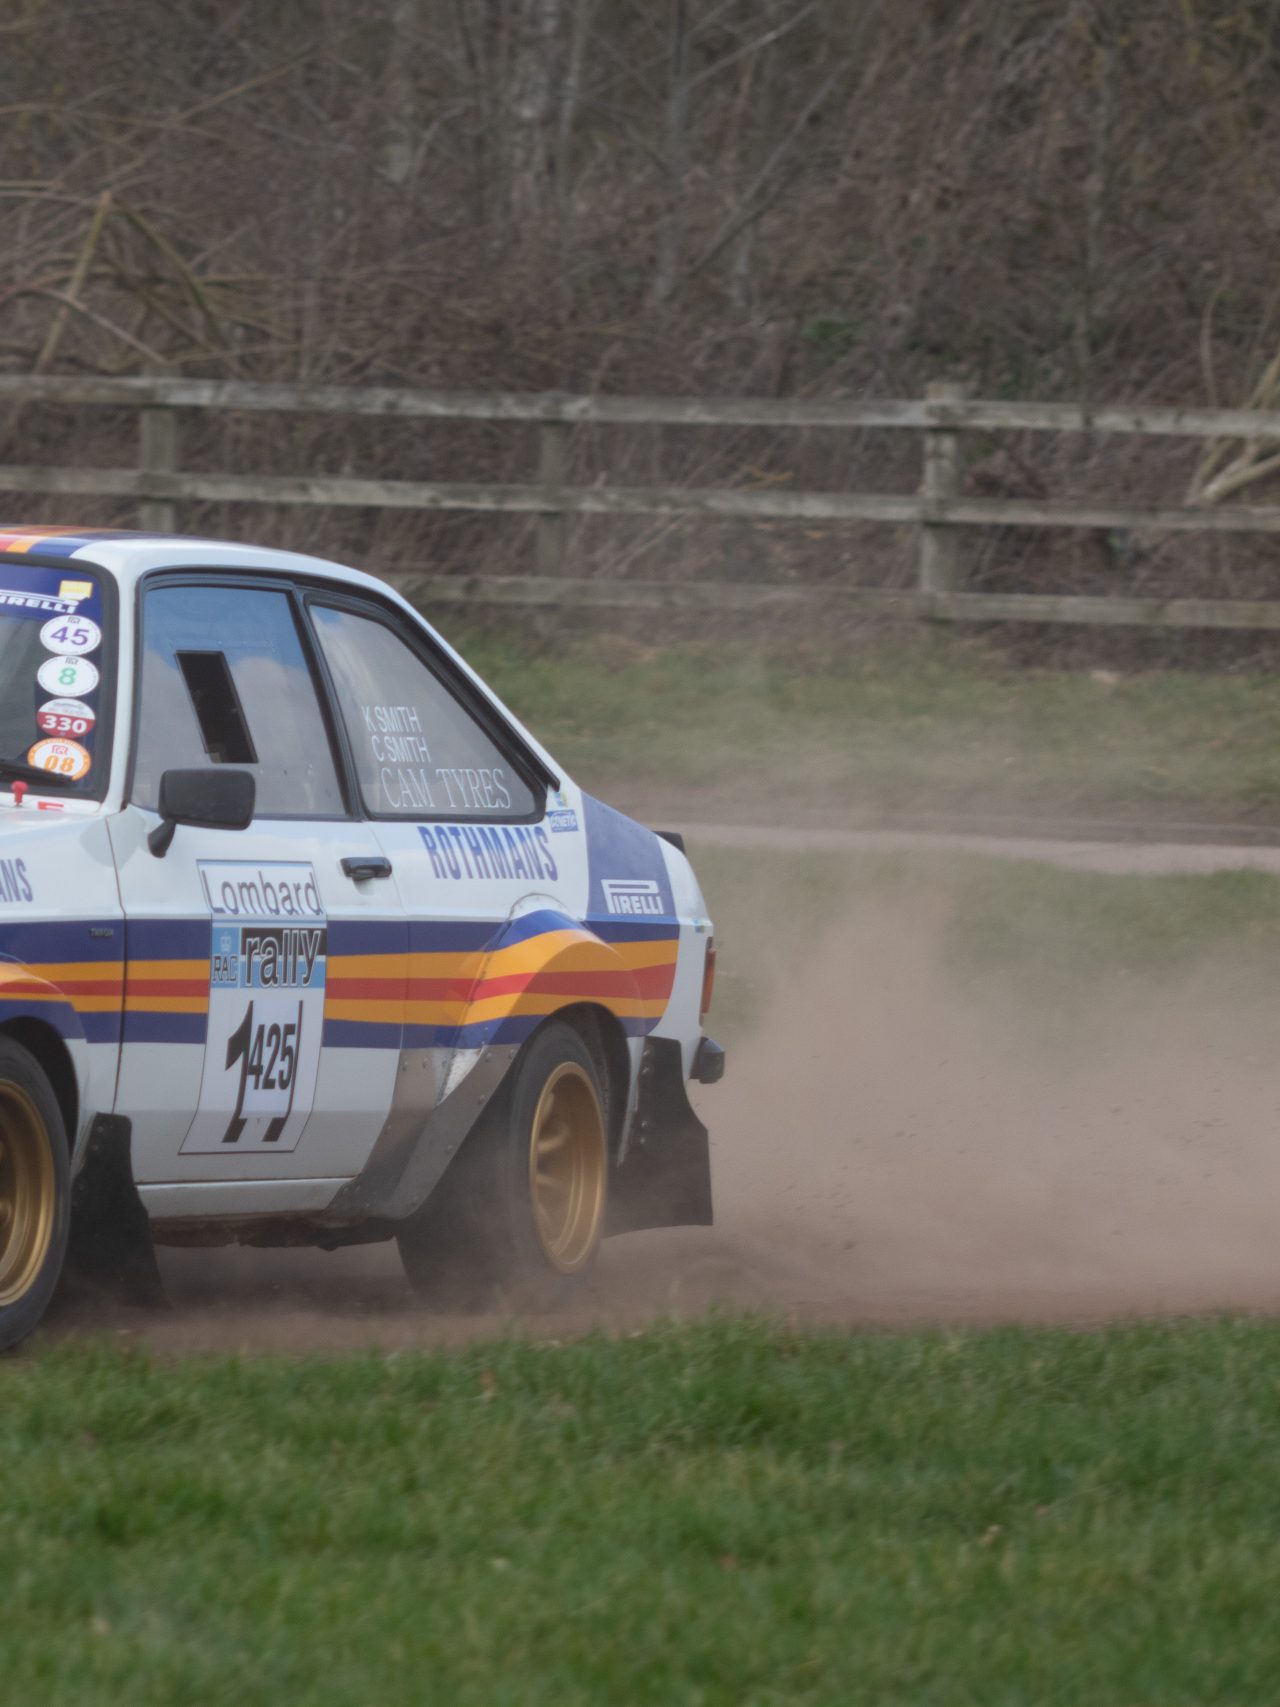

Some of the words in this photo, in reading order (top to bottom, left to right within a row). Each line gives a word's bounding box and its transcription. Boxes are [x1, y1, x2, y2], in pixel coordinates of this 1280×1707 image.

[50, 626, 89, 646] 45
[58, 667, 77, 685] 8
[42, 714, 87, 733] 330
[361, 705, 376, 732] K
[374, 706, 422, 732] SMITH
[371, 735, 384, 762] C
[384, 735, 431, 763] SMITH
[44, 755, 75, 773] 08
[381, 767, 435, 808] CAM
[435, 768, 511, 809] TYRES
[417, 825, 559, 882] ROTHMANS
[202, 869, 323, 915] Lombard
[601, 879, 665, 915] PIRELLI
[212, 954, 238, 982] RAC
[241, 929, 322, 989] rally
[247, 1022, 296, 1091] 425
